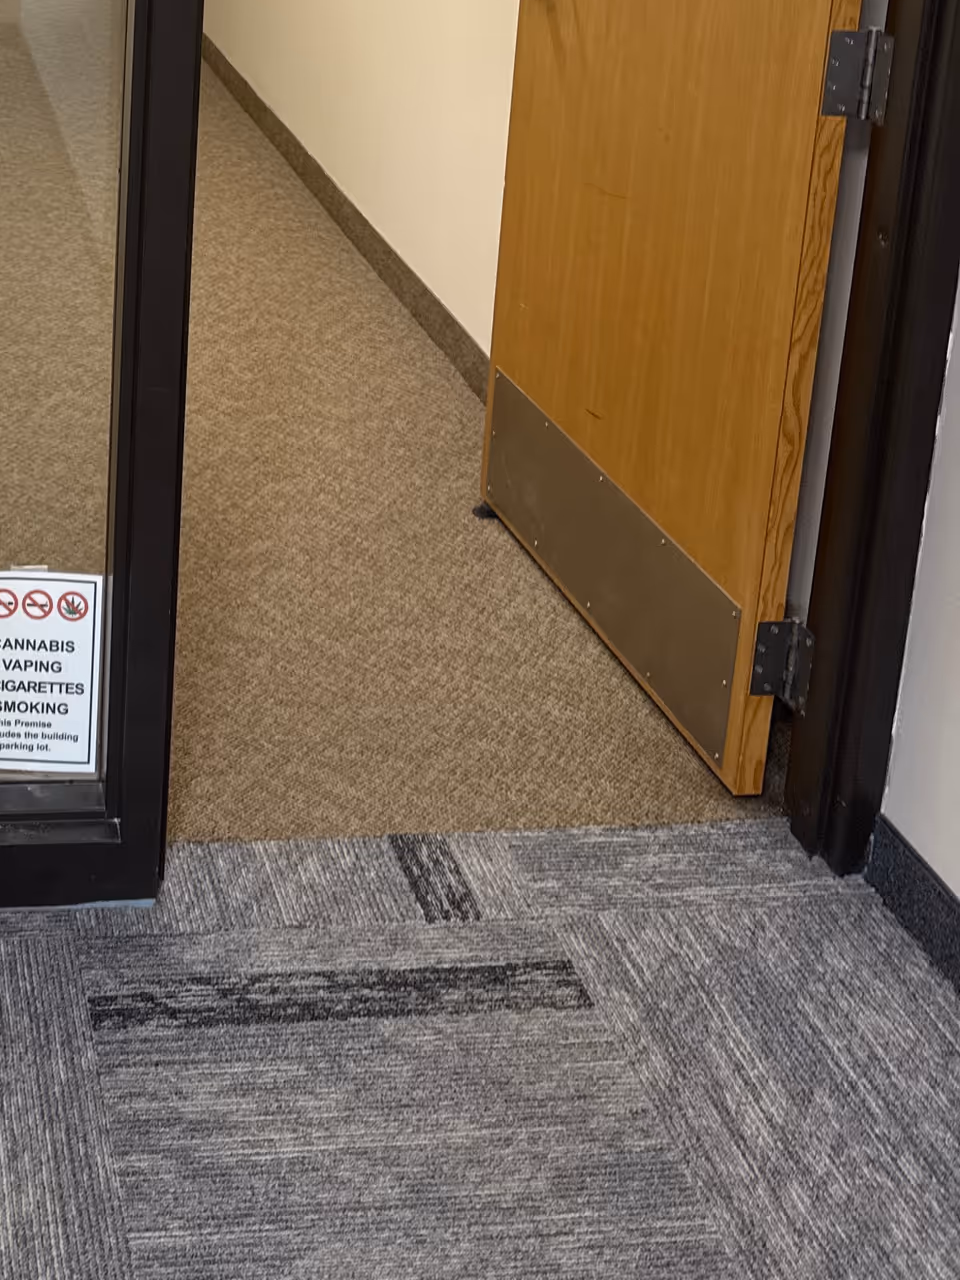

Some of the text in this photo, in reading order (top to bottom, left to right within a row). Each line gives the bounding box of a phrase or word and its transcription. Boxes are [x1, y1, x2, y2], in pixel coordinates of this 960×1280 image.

[2, 659, 63, 673] VAPING
[14, 719, 52, 729] Premise
[24, 730, 39, 740] the
[41, 731, 79, 743] building
[0, 742, 34, 753] parking
[36, 742, 51, 752] lot.
